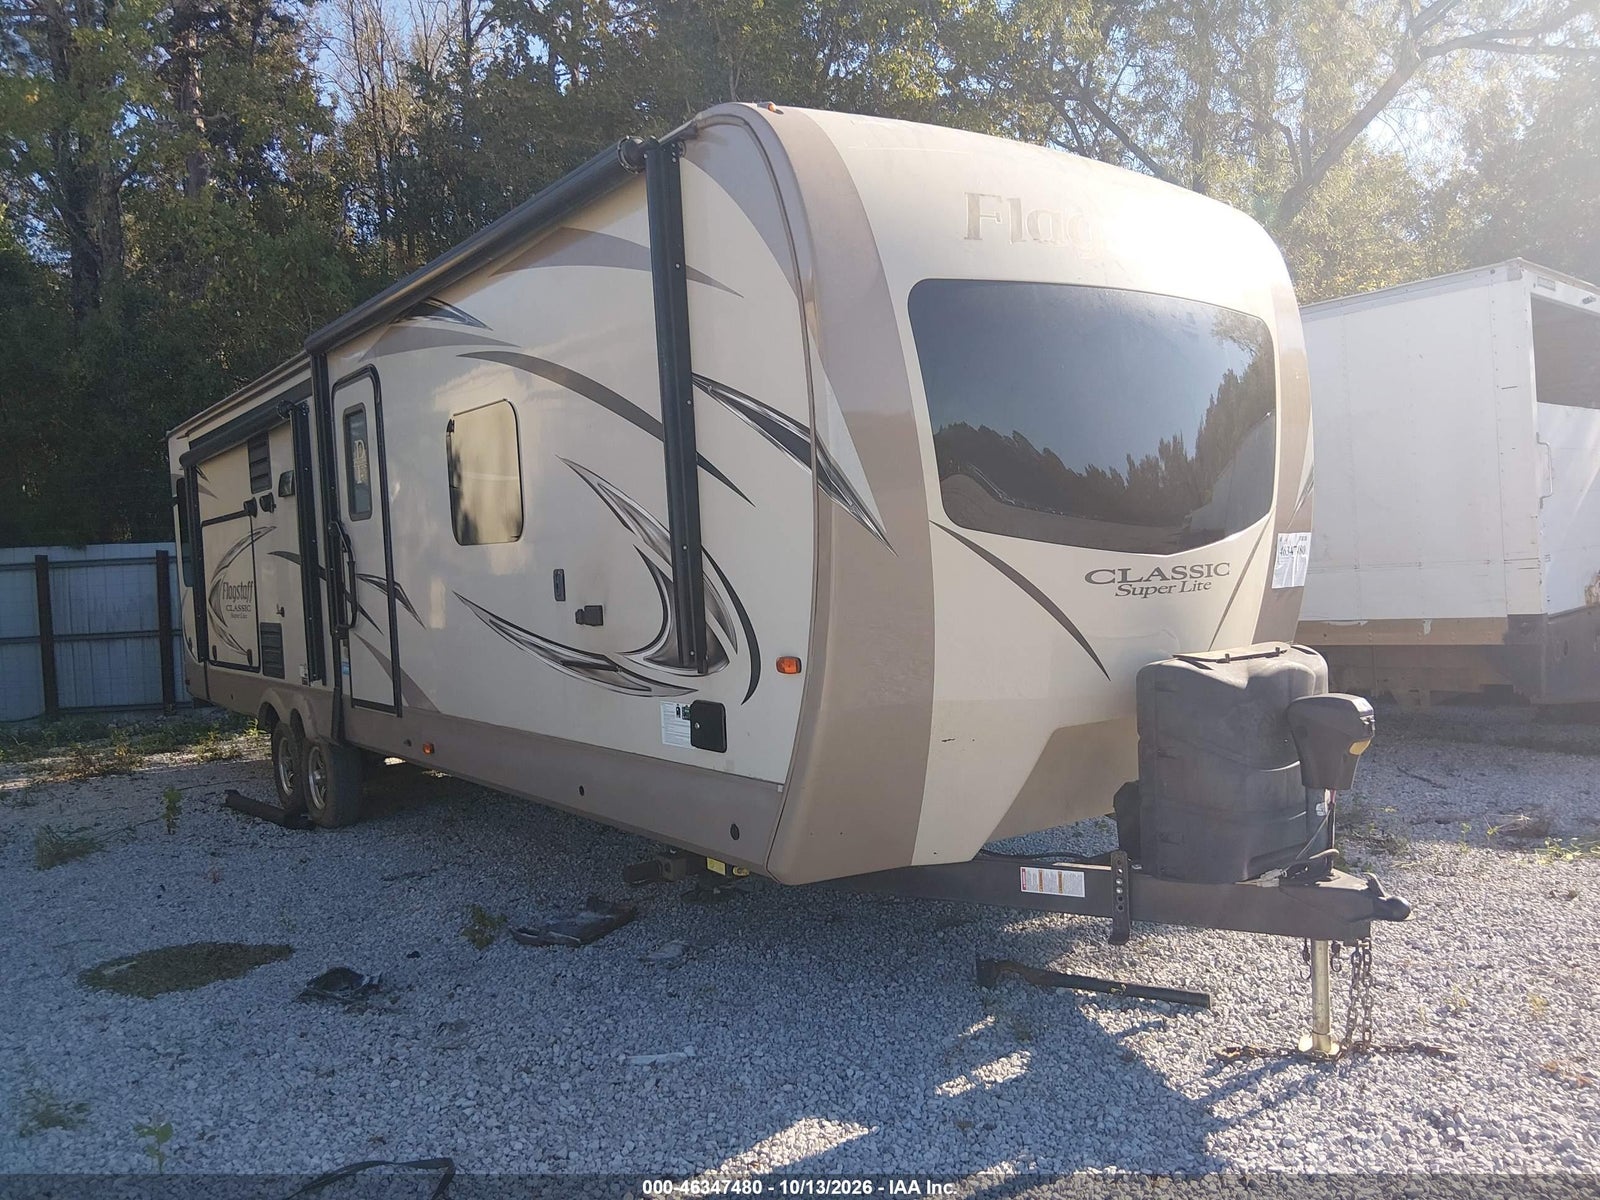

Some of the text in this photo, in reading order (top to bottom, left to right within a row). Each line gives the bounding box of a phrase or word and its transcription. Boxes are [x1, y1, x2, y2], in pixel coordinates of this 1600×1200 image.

[1084, 562, 1231, 585] CLASSIC
[222, 581, 253, 603] Flagstaff
[1115, 580, 1212, 599] Super Lite
[226, 604, 251, 612] CLASSIC
